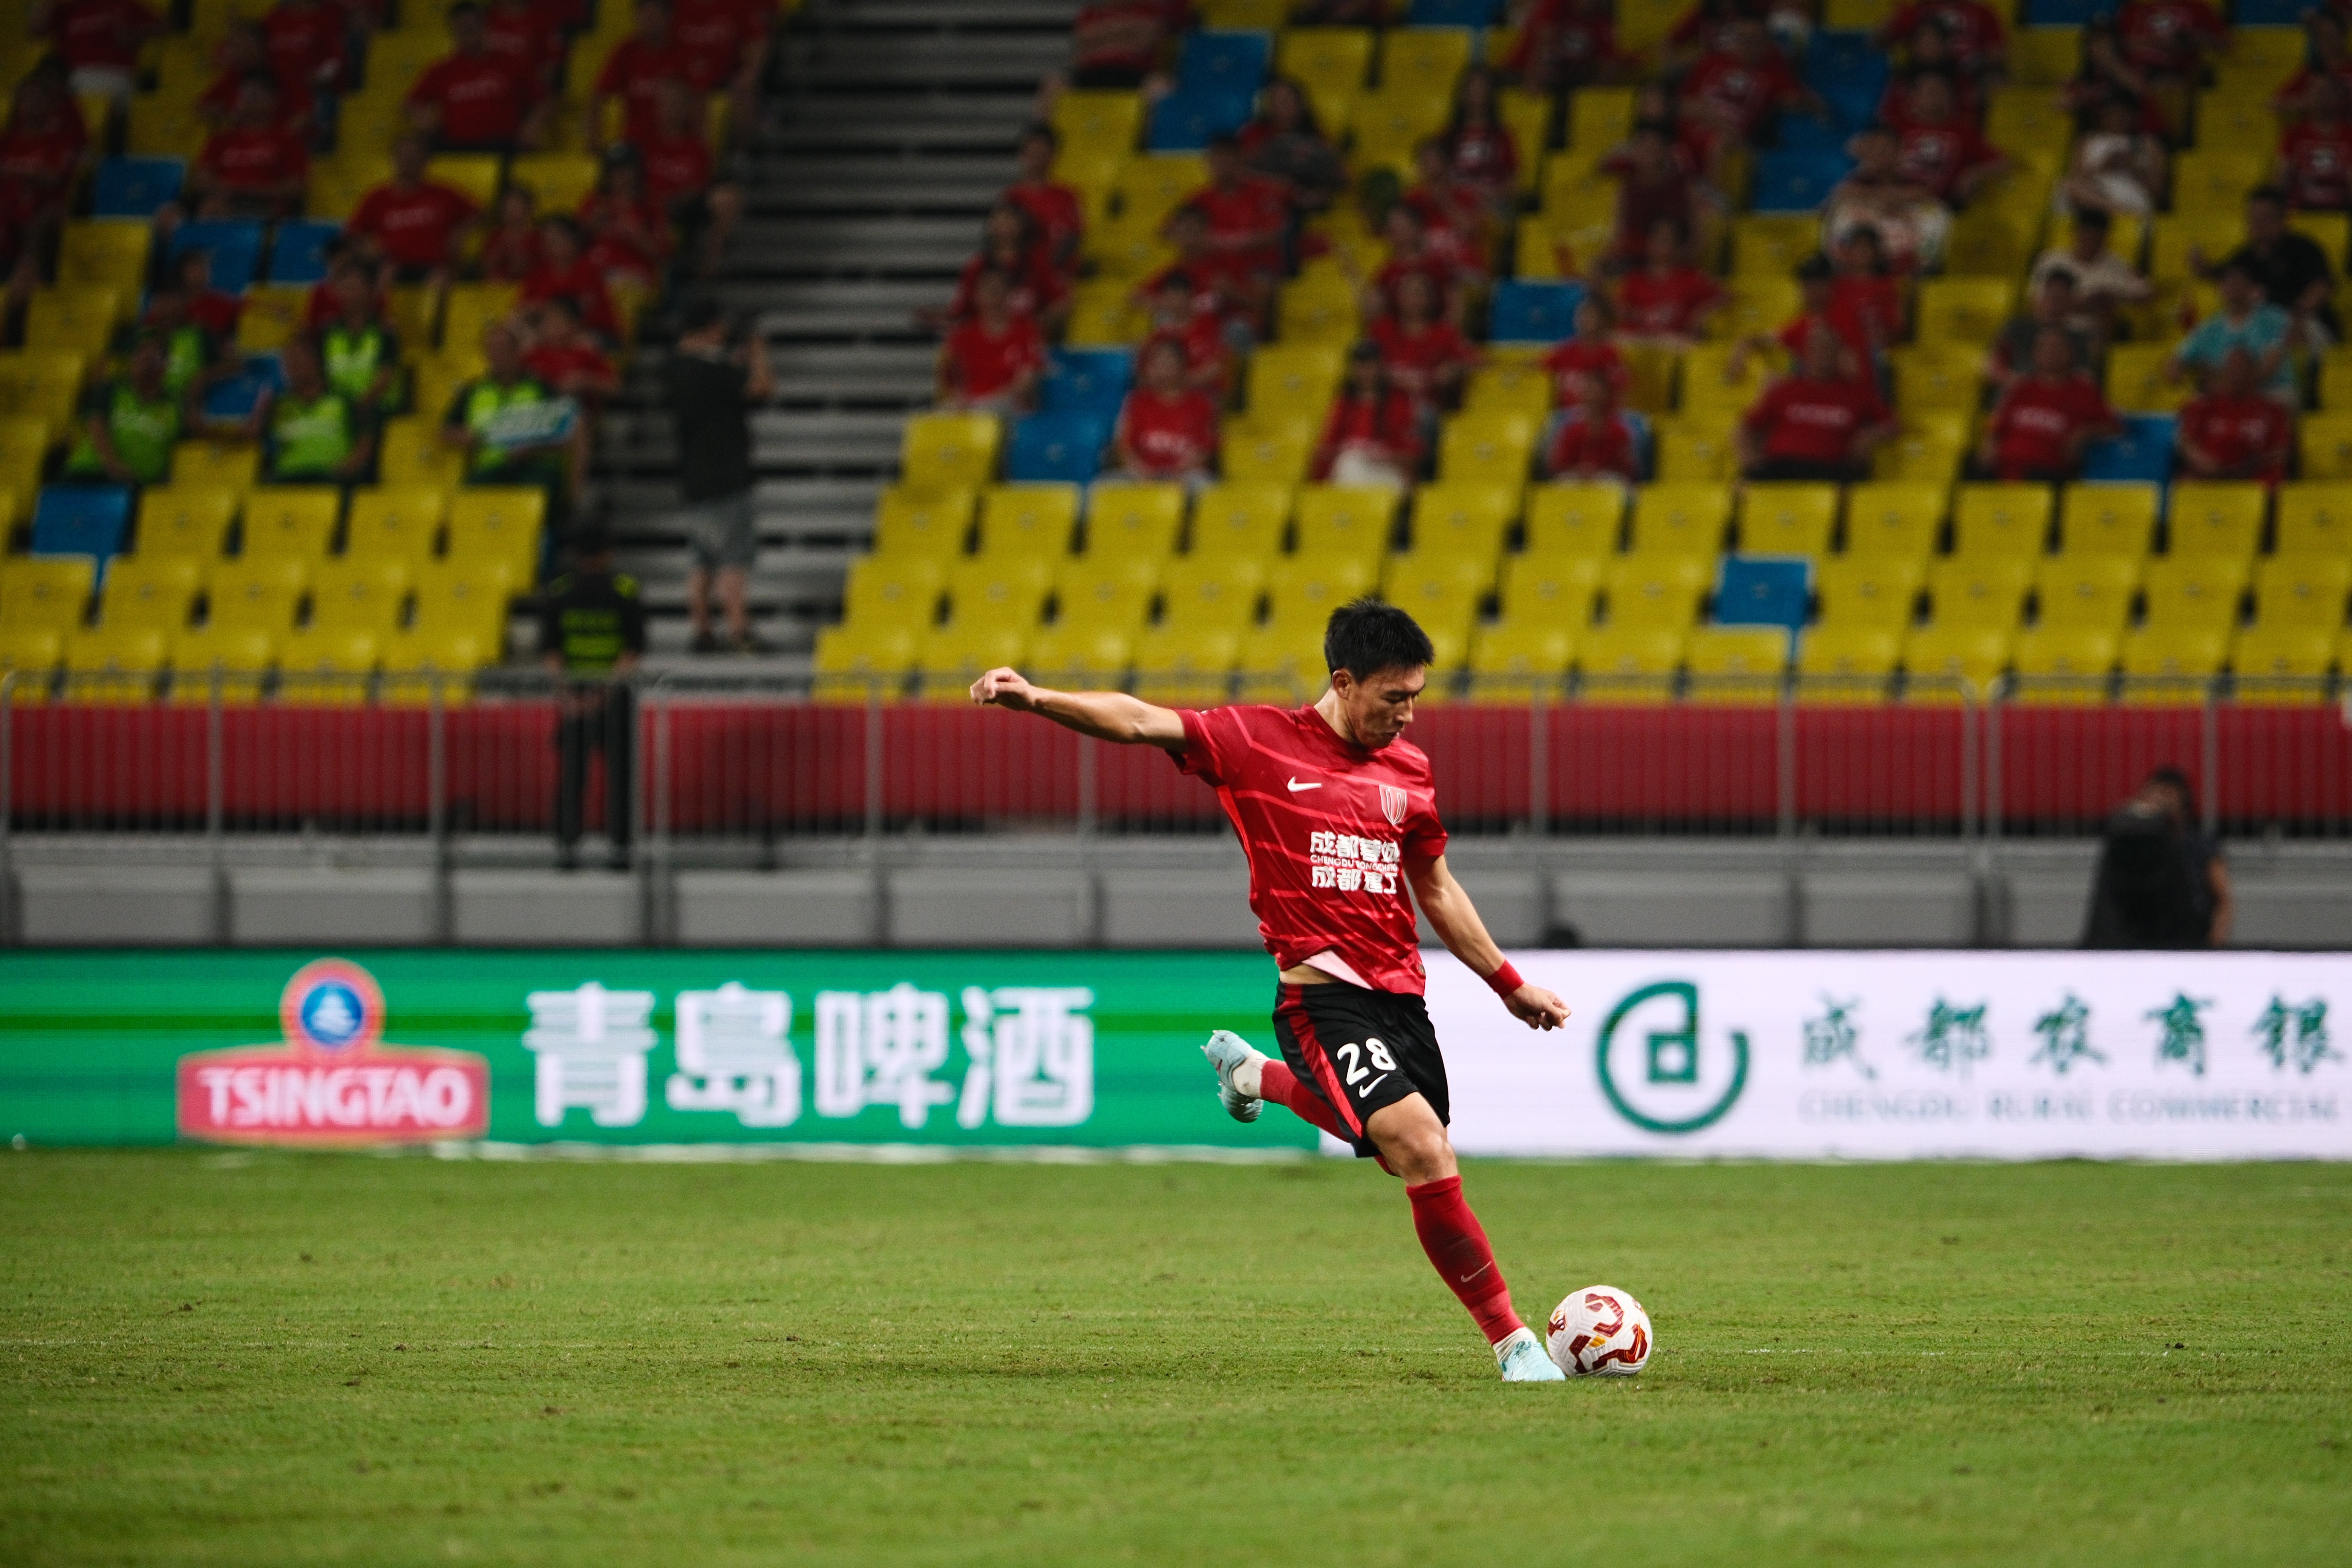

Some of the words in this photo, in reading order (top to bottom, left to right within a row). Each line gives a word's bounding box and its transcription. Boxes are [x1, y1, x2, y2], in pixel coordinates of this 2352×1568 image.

[1310, 854, 1354, 868] CHENGDU
[1311, 865, 1398, 895] 成都建工
[1337, 1037, 1397, 1086] 28
[198, 1067, 471, 1127] TSINGTAO
